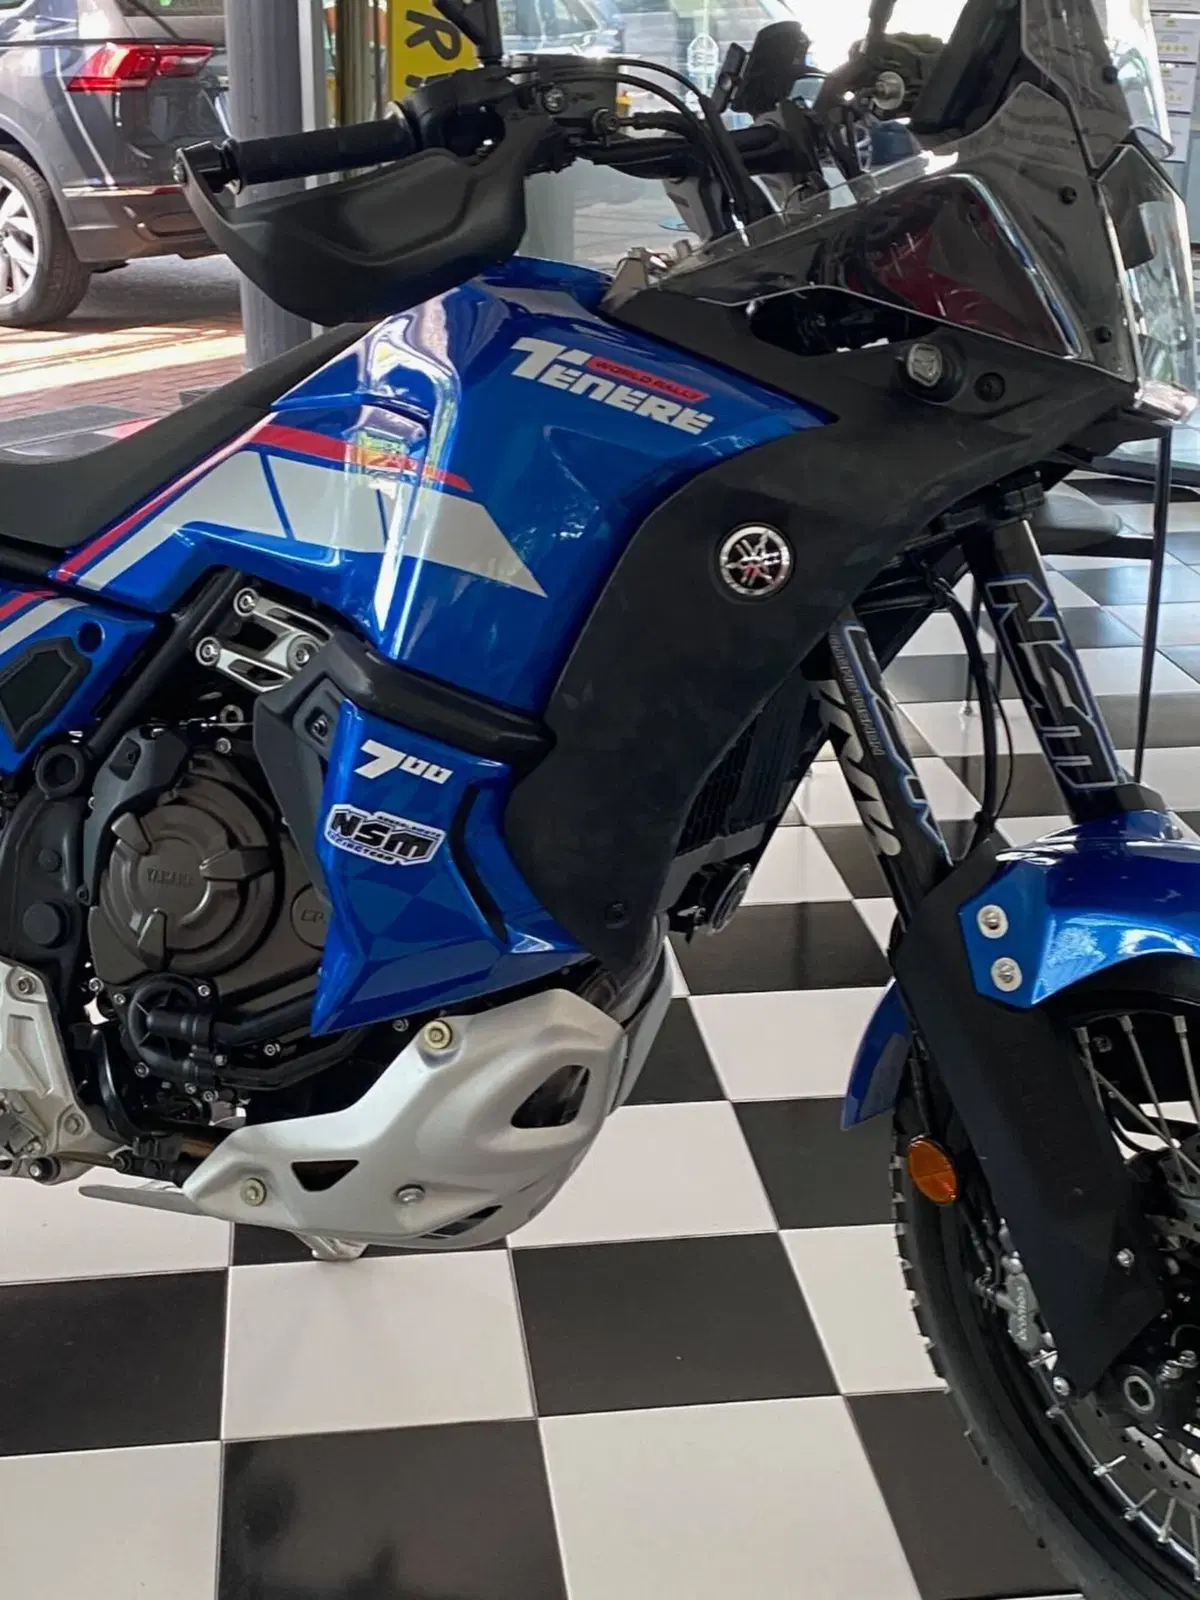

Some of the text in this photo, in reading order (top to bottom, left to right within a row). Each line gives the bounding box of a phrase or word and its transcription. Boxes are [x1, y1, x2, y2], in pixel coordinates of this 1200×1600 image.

[405, 9, 462, 88] R
[353, 739, 454, 785] 700
[330, 811, 435, 860] NSM
